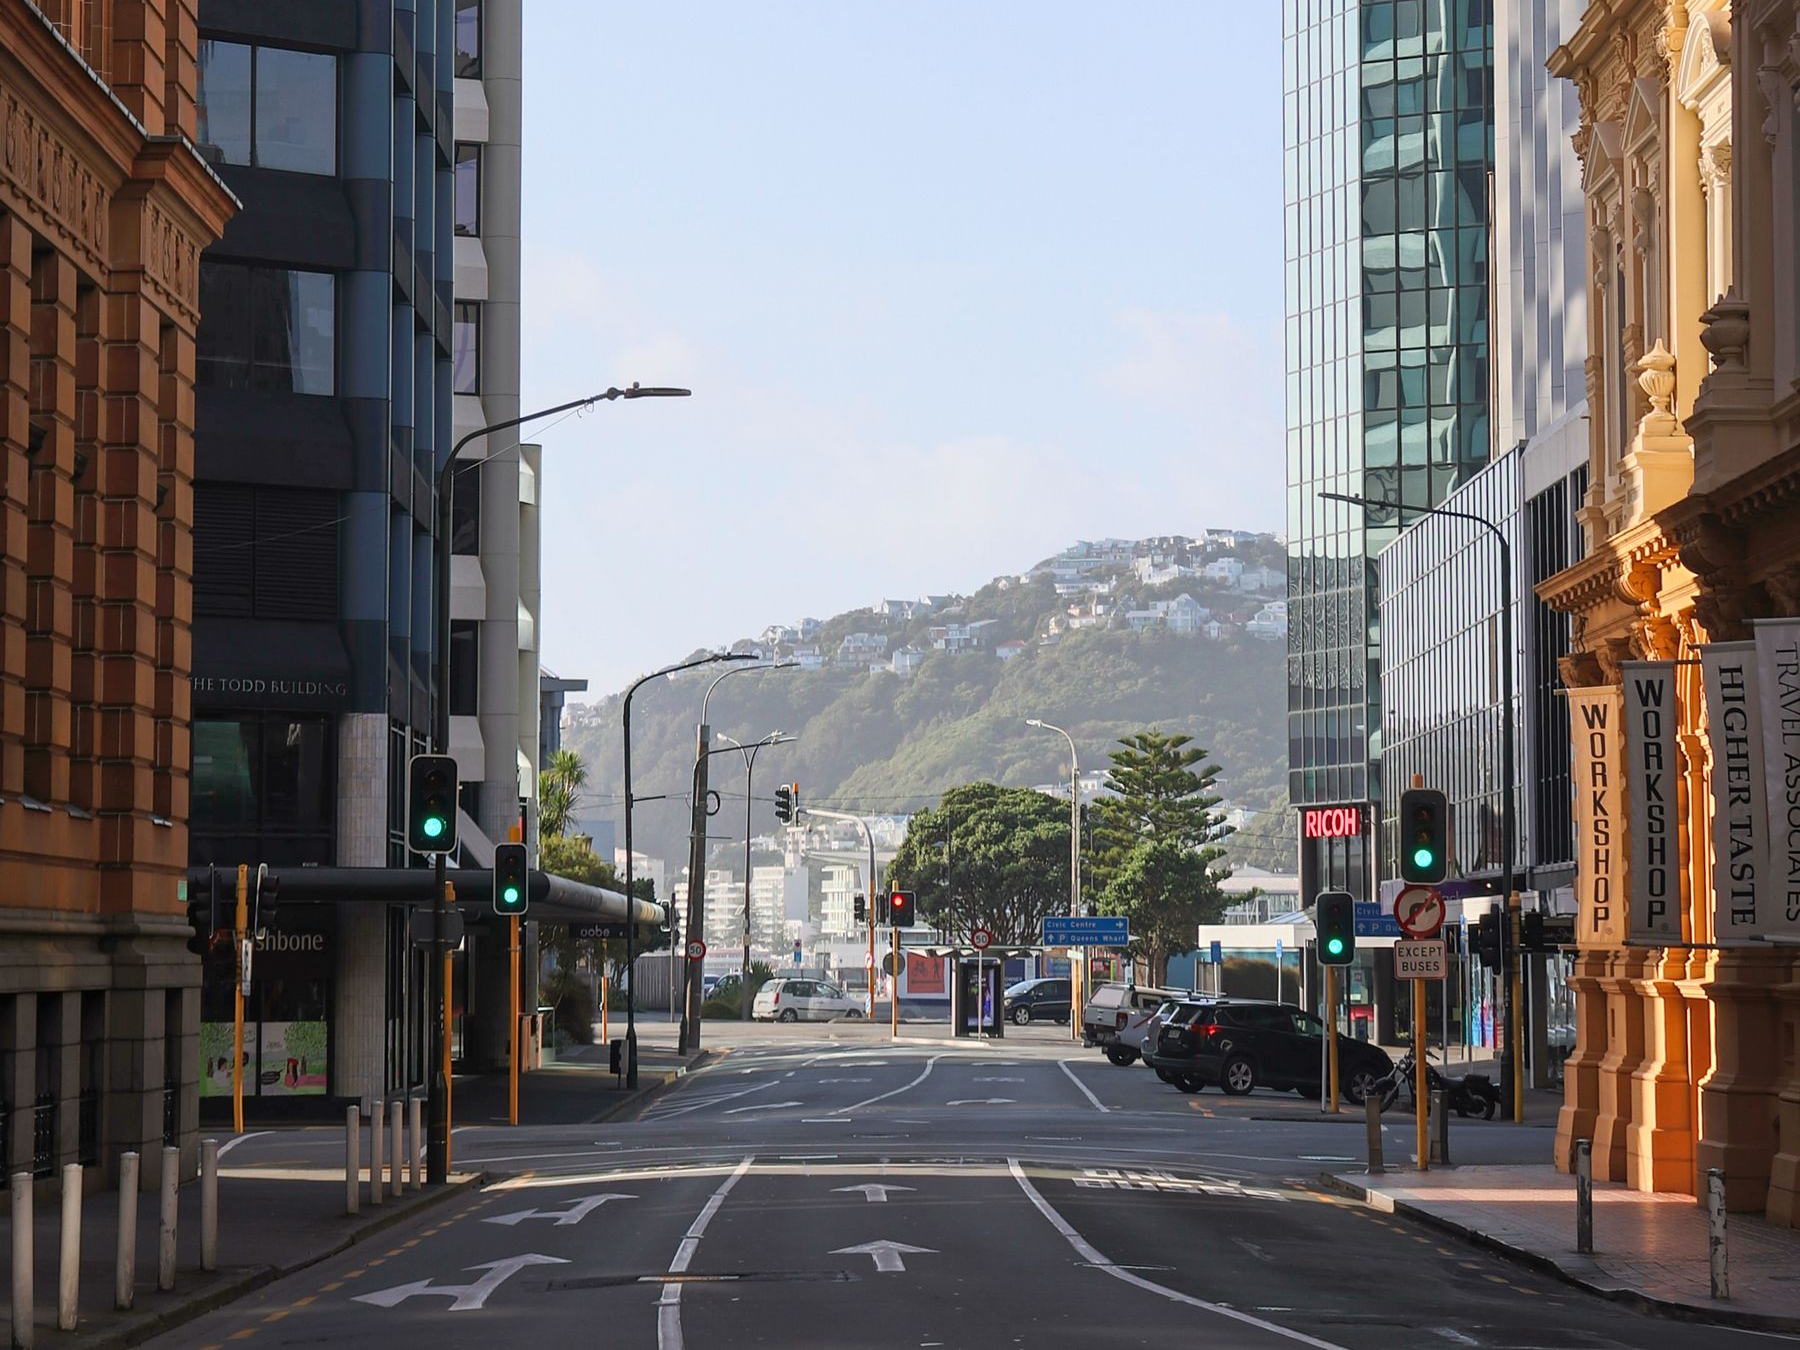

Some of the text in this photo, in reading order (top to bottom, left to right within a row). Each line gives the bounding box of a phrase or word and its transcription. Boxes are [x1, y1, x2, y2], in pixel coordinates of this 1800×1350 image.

[190, 677, 347, 696] HE TODD BUILDING
[1776, 641, 1800, 745] TRAVEL
[1634, 679, 1666, 928] WORKSHOP
[1718, 665, 1756, 926] HIGHER TASTE
[1305, 808, 1356, 838] RICOH
[1581, 703, 1610, 933] WORKSHOP
[690, 946, 701, 954] 50
[976, 935, 987, 943] 50
[1398, 946, 1442, 958] EXCEPT
[1402, 961, 1440, 971] BUSES
